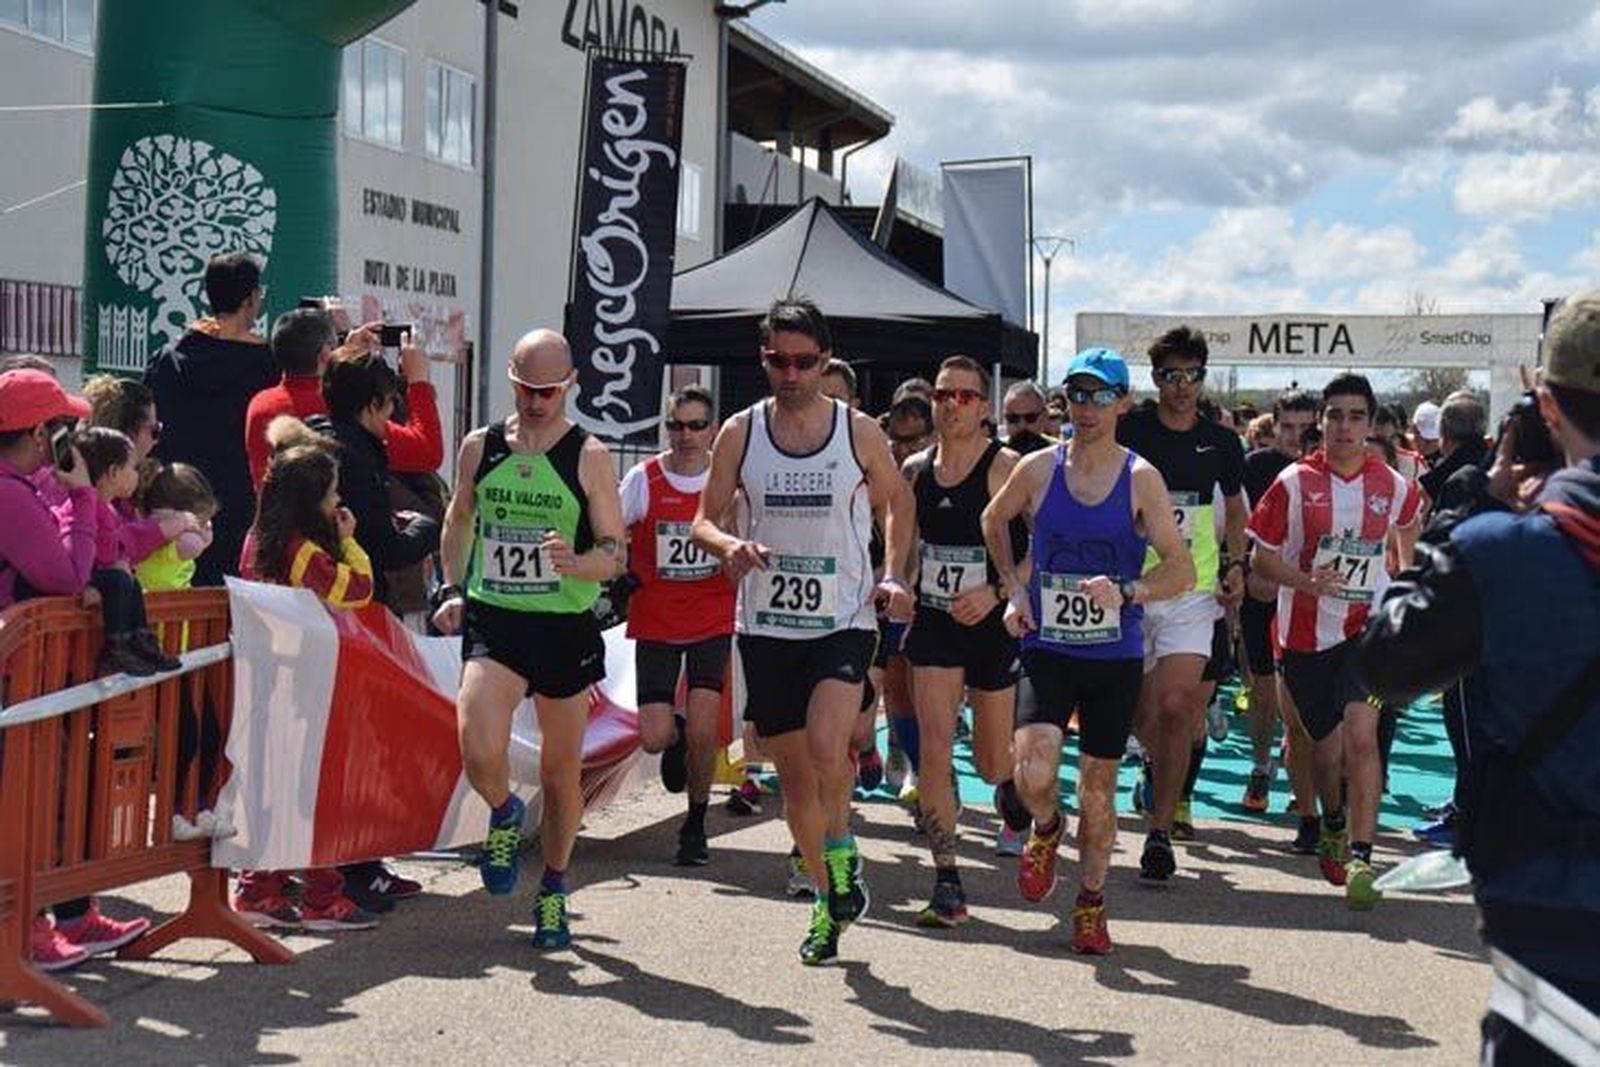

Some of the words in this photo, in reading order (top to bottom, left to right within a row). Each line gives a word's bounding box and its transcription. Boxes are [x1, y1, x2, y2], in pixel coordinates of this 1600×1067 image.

[363, 187, 406, 222] ESTADIO
[411, 198, 461, 234] MUNICIPAL
[364, 259, 391, 288] RUTA
[396, 264, 410, 292] DE
[413, 267, 426, 293] LA
[428, 270, 457, 297] PLATA
[1248, 322, 1355, 355] META
[1419, 330, 1492, 346] SmartChip
[765, 472, 780, 492] LA
[515, 490, 563, 509] VALORIO
[493, 545, 542, 578] 121
[769, 574, 823, 612] 239
[937, 564, 965, 593] 47
[1055, 593, 1105, 627] 299
